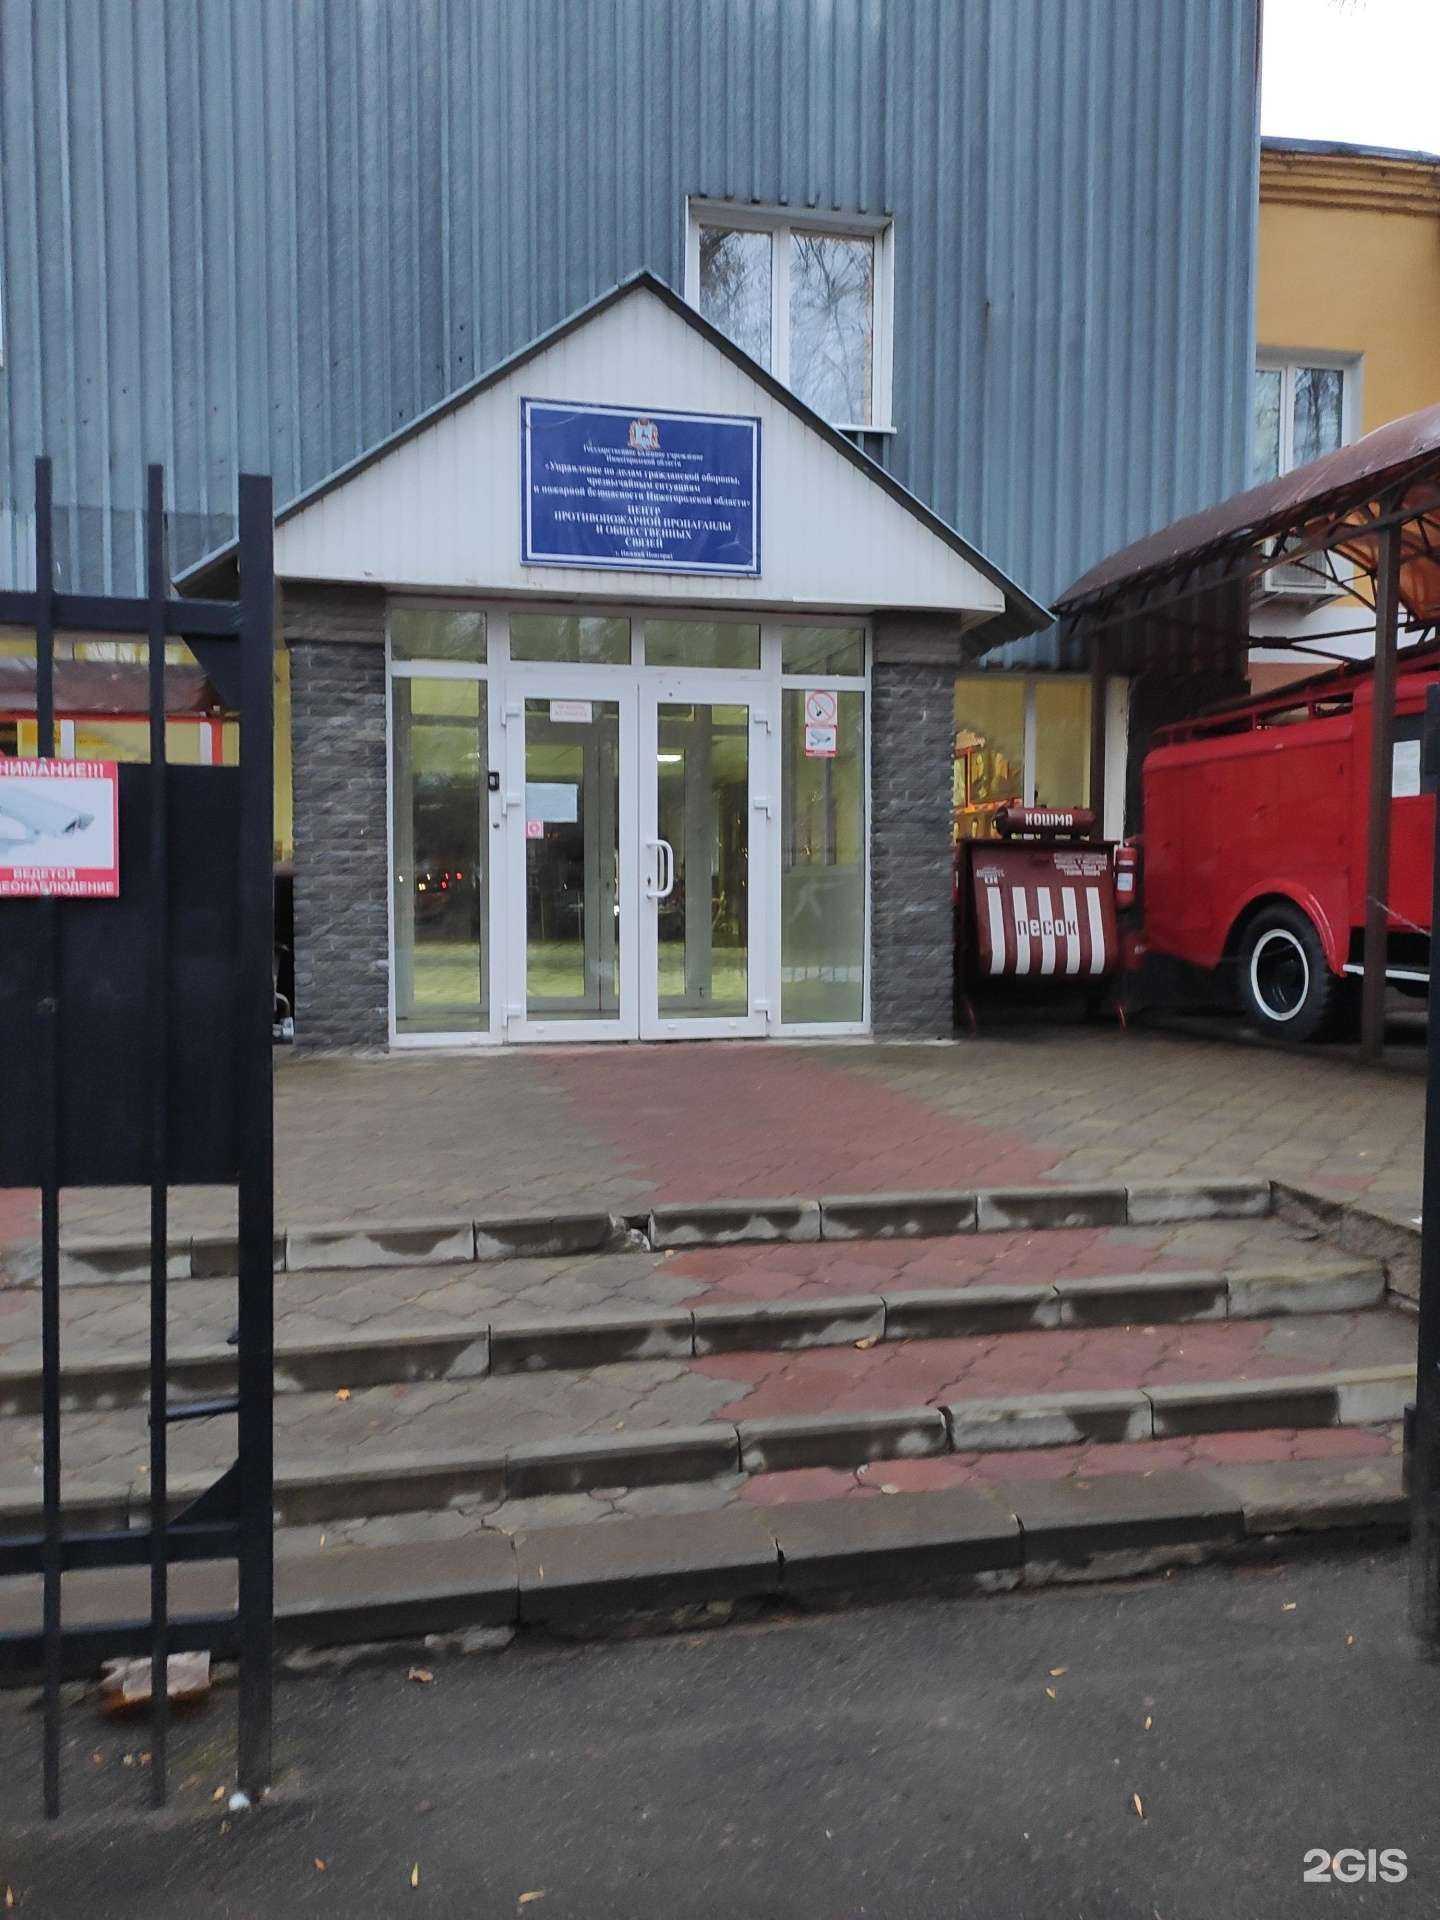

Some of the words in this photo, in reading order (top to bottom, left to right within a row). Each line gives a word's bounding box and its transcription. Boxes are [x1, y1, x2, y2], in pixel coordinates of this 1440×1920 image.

[603, 467, 615, 476] по
[618, 468, 643, 479] делам
[644, 470, 700, 482] гражданской
[586, 477, 653, 491] чрезвычайным
[655, 481, 701, 493] ситуациям
[533, 484, 540, 494] и
[541, 485, 586, 498] пожарной
[587, 486, 645, 501] безопасности
[646, 491, 713, 506] Нижегородской
[627, 504, 661, 516] ЦЕНТР
[554, 510, 661, 527] ПРОТИВОПОЖАРНОЙ
[663, 517, 731, 532] ПРОПАГАНДЫ
[595, 524, 604, 535] И
[605, 525, 692, 540] ОБЩЕСТВЕННЫХ
[624, 536, 664, 549] СВЯЗЕЙ
[1025, 812, 1073, 827] КОШМА
[13, 866, 76, 881] ВЕДЕТСЯ
[0, 880, 114, 896] ЕОНАБЛЮДЕНИЕ
